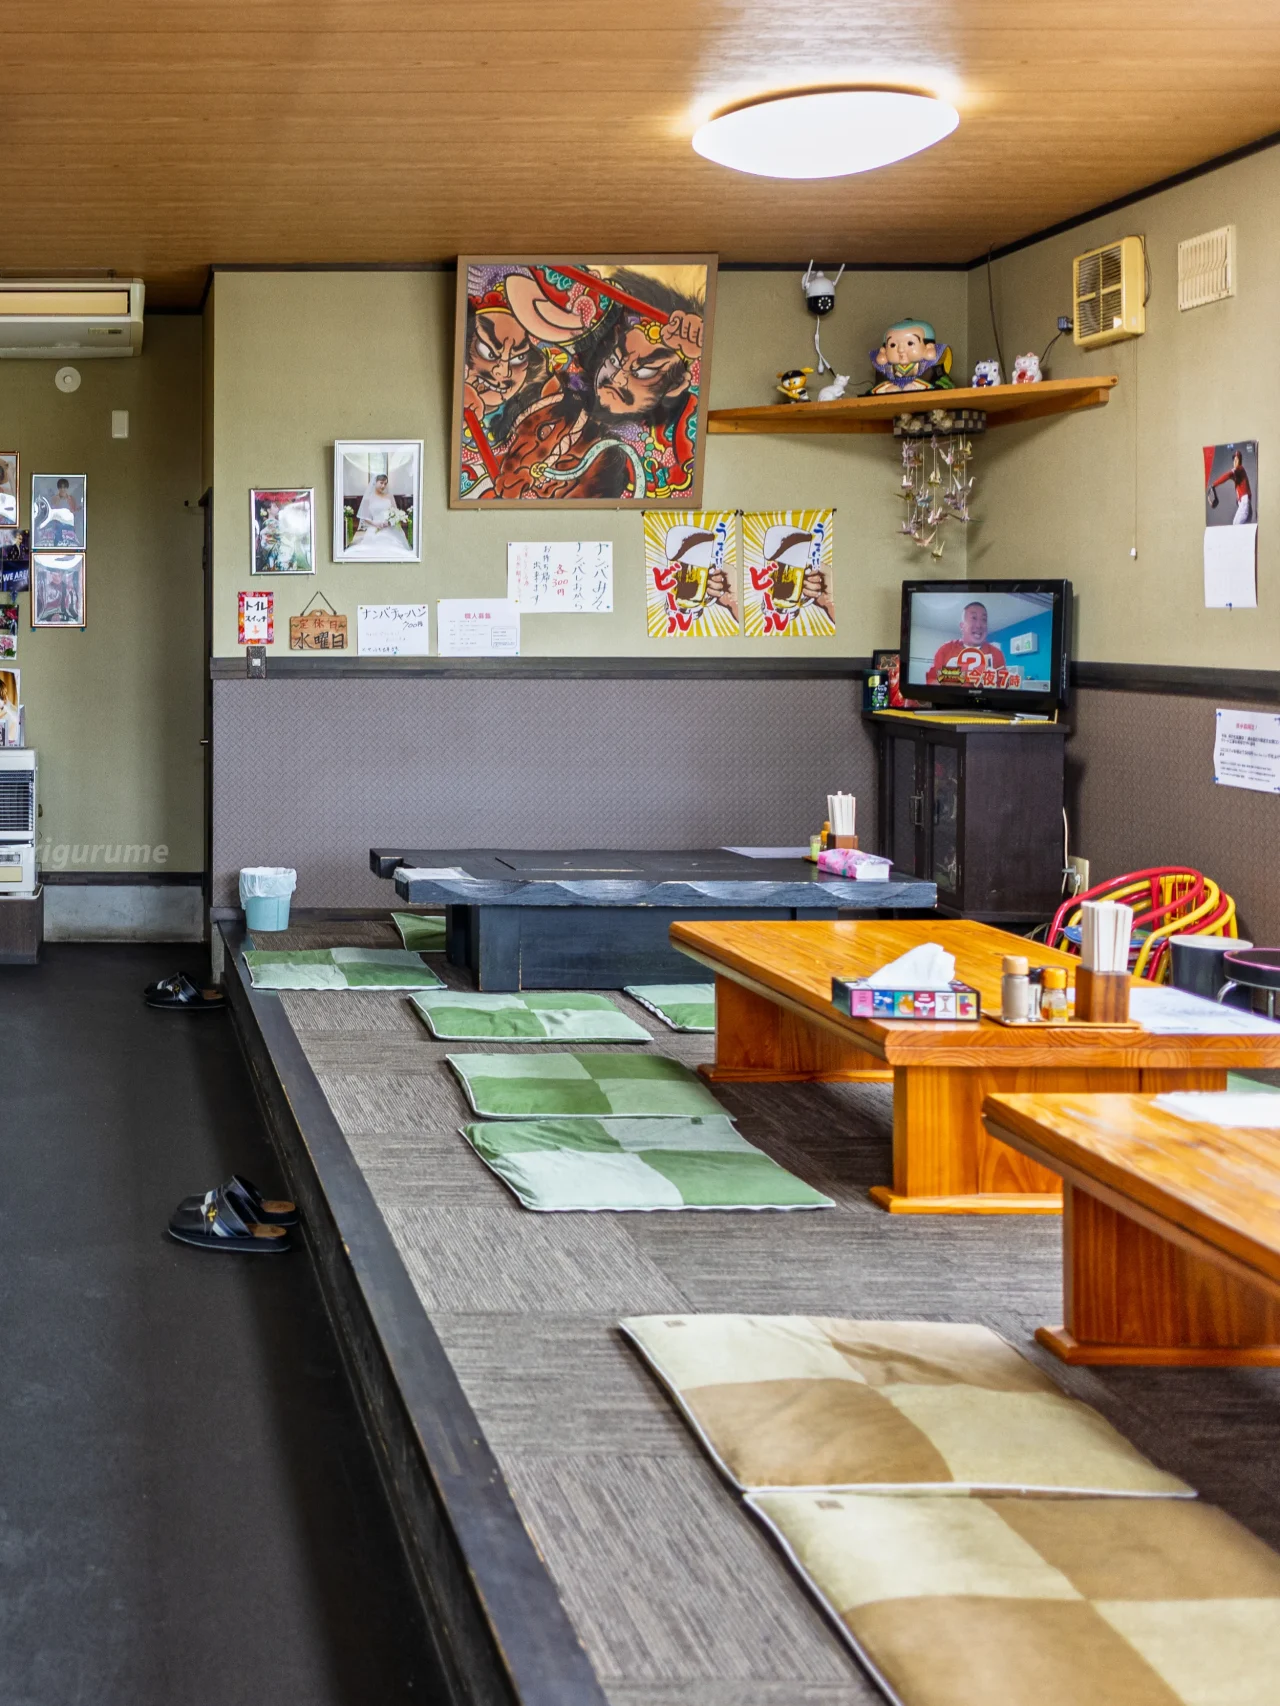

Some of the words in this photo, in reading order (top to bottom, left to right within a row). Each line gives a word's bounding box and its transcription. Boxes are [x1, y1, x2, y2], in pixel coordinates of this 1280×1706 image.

[3, 573, 14, 581] WE
[246, 601, 268, 611] トイレ
[652, 562, 692, 633] ビール
[749, 562, 789, 633] ビール
[294, 632, 344, 649] 水曜日
[968, 669, 1021, 687] 今夜7時
